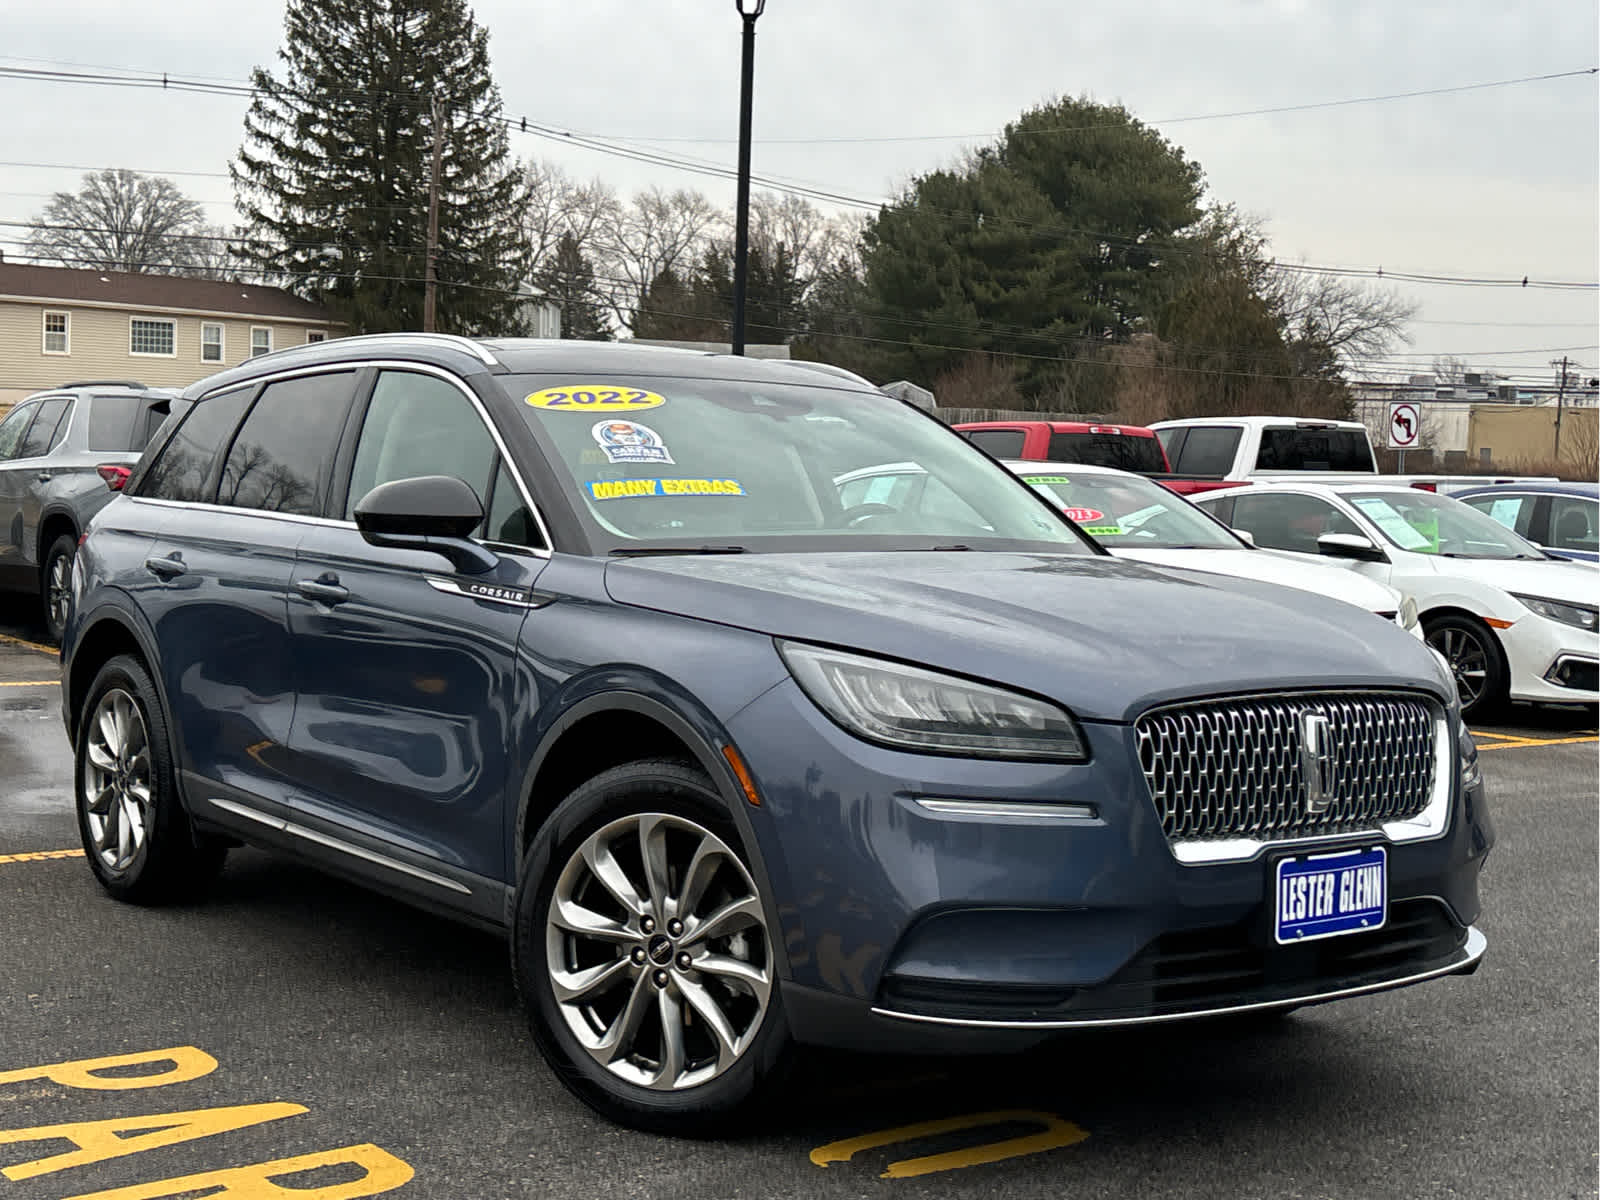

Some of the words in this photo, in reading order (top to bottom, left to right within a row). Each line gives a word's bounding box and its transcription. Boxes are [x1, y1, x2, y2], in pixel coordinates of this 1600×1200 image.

[545, 391, 652, 406] 2022
[592, 480, 656, 499] MANY
[662, 479, 742, 495] EXTRAS
[1065, 510, 1093, 520] 013
[471, 585, 524, 601] CORSAIR
[1281, 873, 1335, 922] LESTER
[1339, 865, 1382, 913] GLENN
[0, 1046, 415, 1200] PAR
